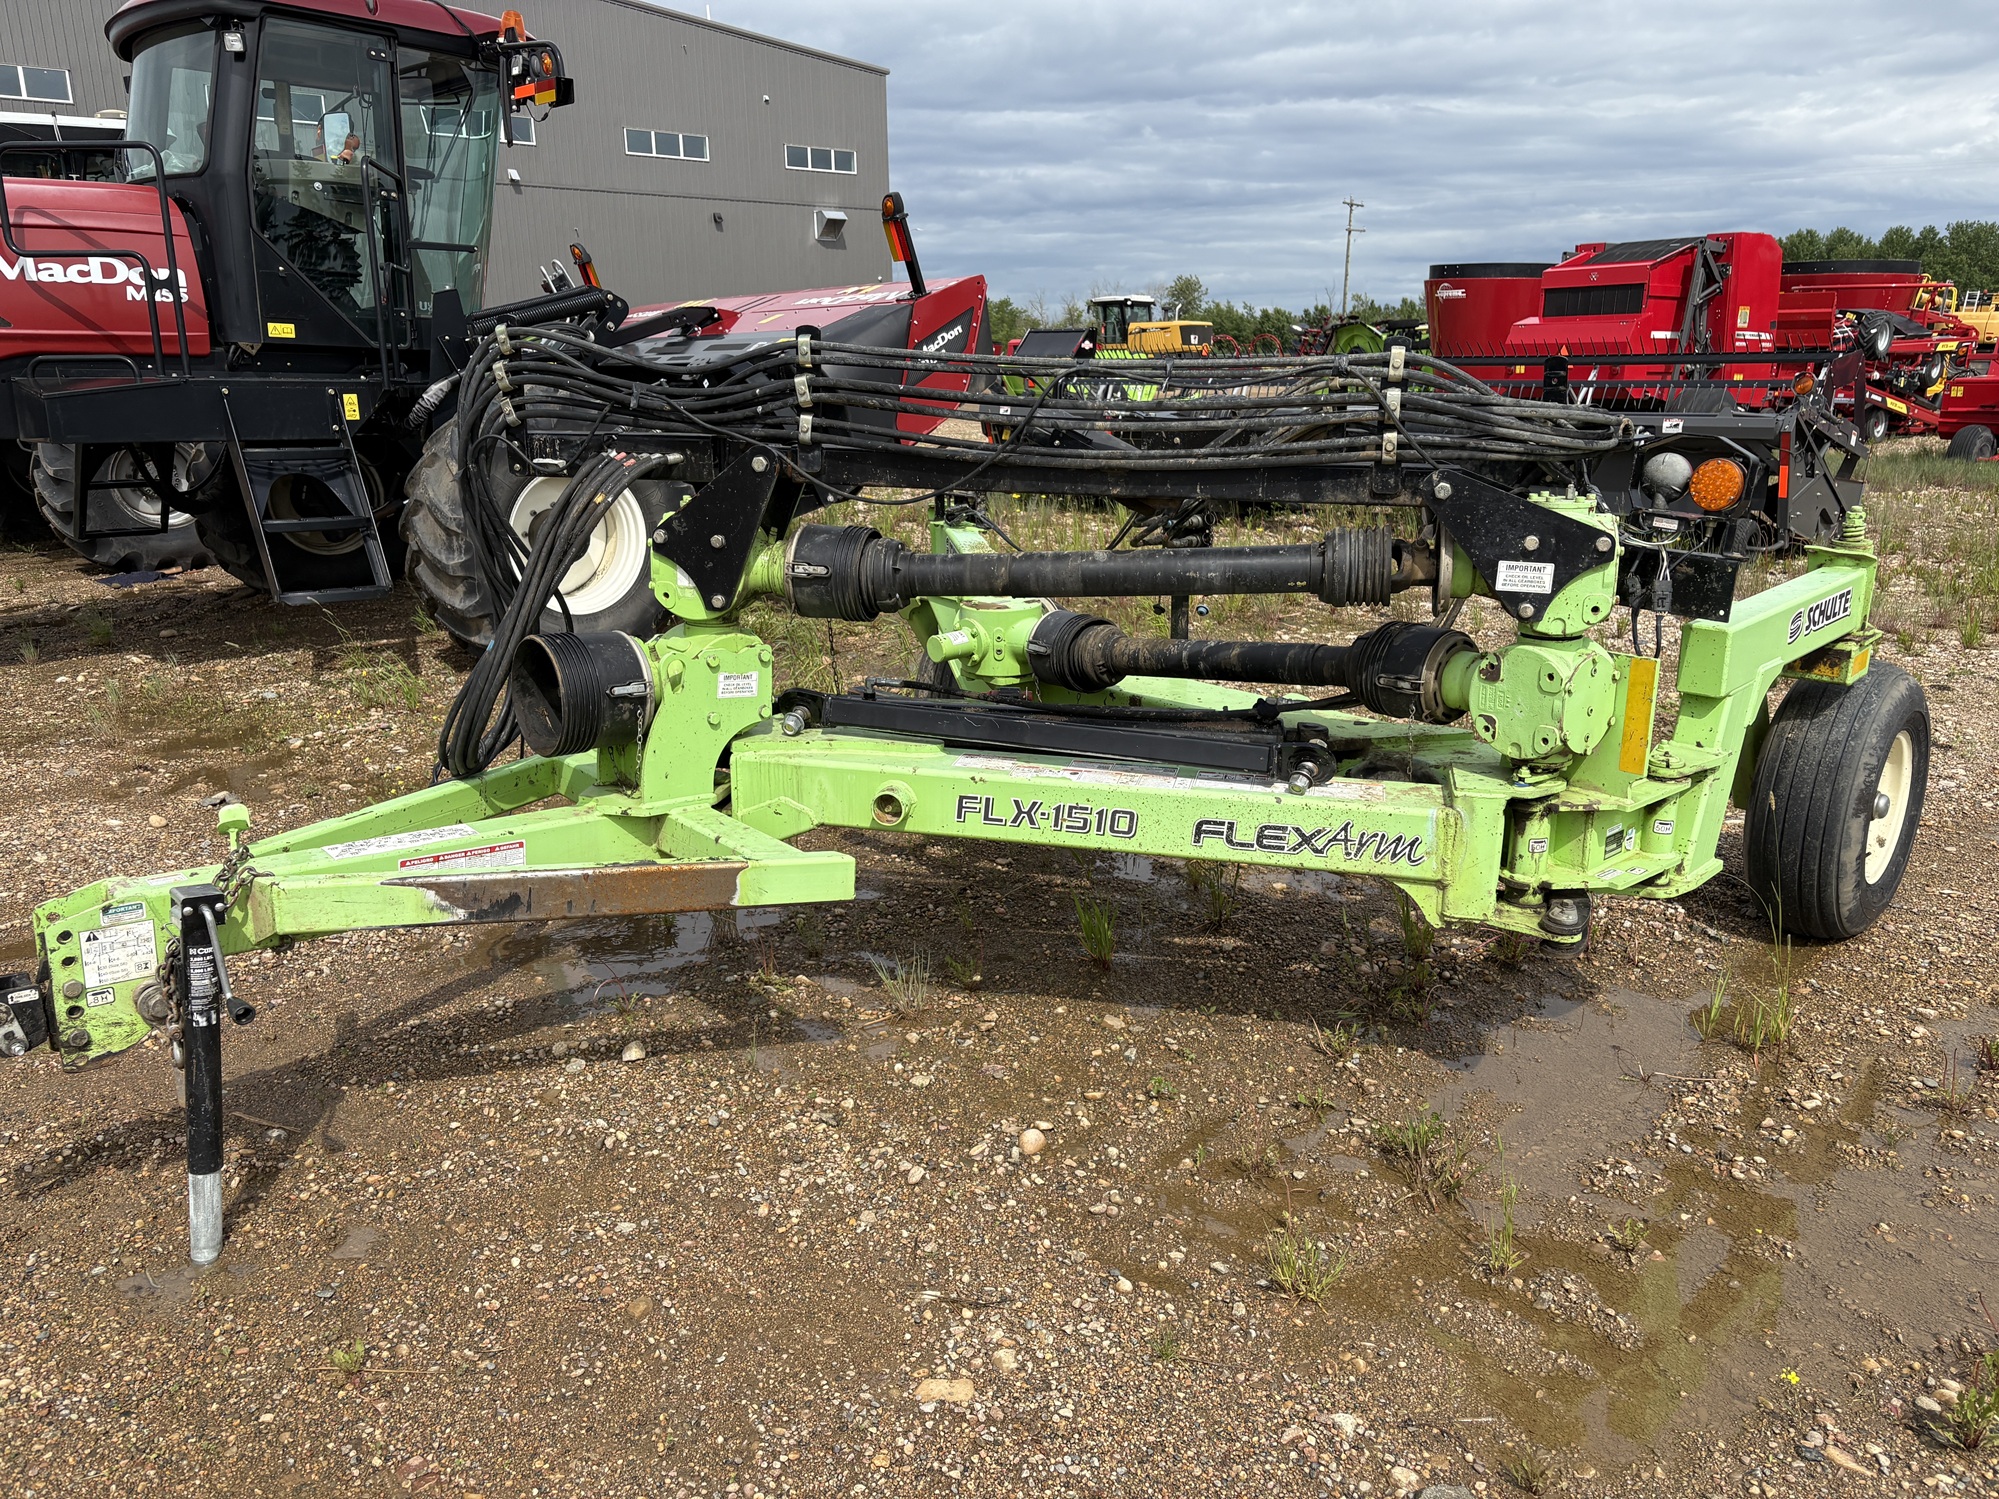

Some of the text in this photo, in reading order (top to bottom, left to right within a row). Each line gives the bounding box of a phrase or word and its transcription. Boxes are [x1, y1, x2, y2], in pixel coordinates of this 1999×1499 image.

[0, 255, 187, 287] MacDon
[1506, 564, 1546, 573] IMPORTANT
[1804, 588, 1853, 634] SCHULTE
[955, 794, 1138, 838] FLX-1510
[444, 852, 466, 860] DANGER
[471, 848, 491, 856] PERIGO
[410, 857, 434, 865] PELIGRO
